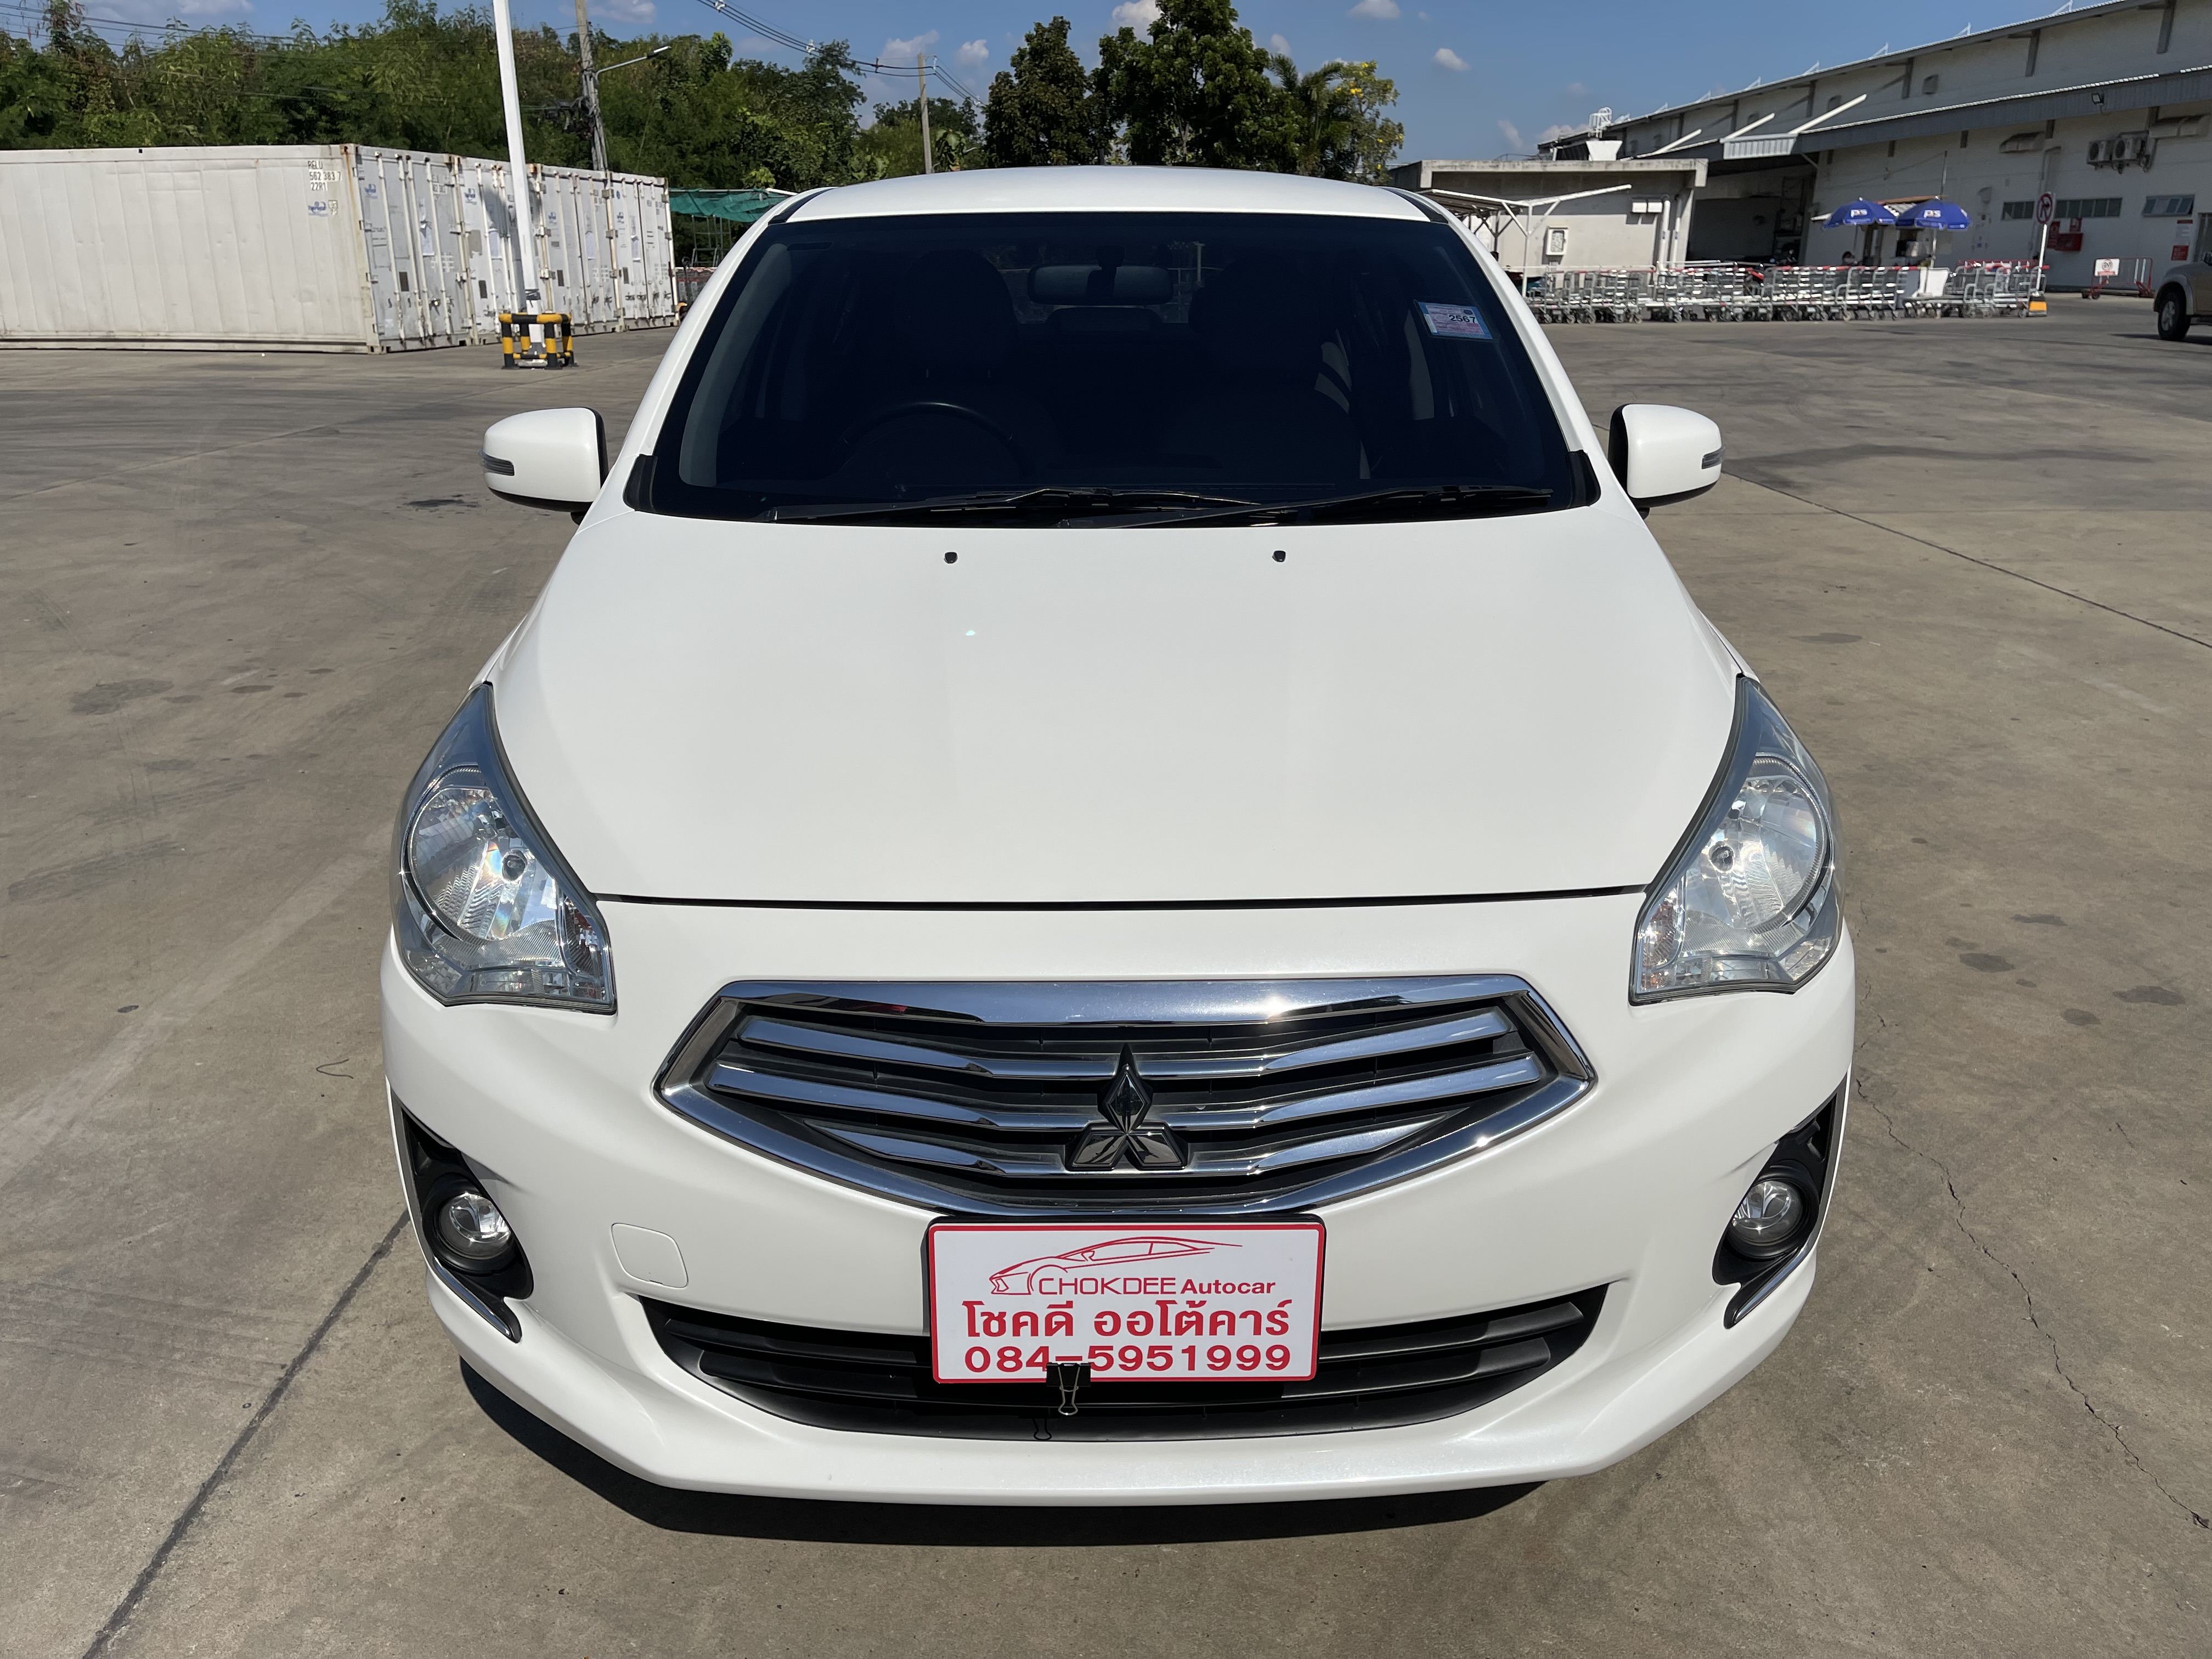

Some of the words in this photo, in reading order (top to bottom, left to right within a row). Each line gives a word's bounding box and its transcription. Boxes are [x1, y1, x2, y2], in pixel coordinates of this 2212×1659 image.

[1449, 314, 1476, 323] 2567
[1039, 1277, 1176, 1295] CHOKDEE
[1181, 1279, 1276, 1295] Autocar
[962, 1300, 1074, 1338] โชคดี
[1094, 1299, 1293, 1337] ออโต้คาร์
[964, 1344, 1291, 1373] 084-5951999
